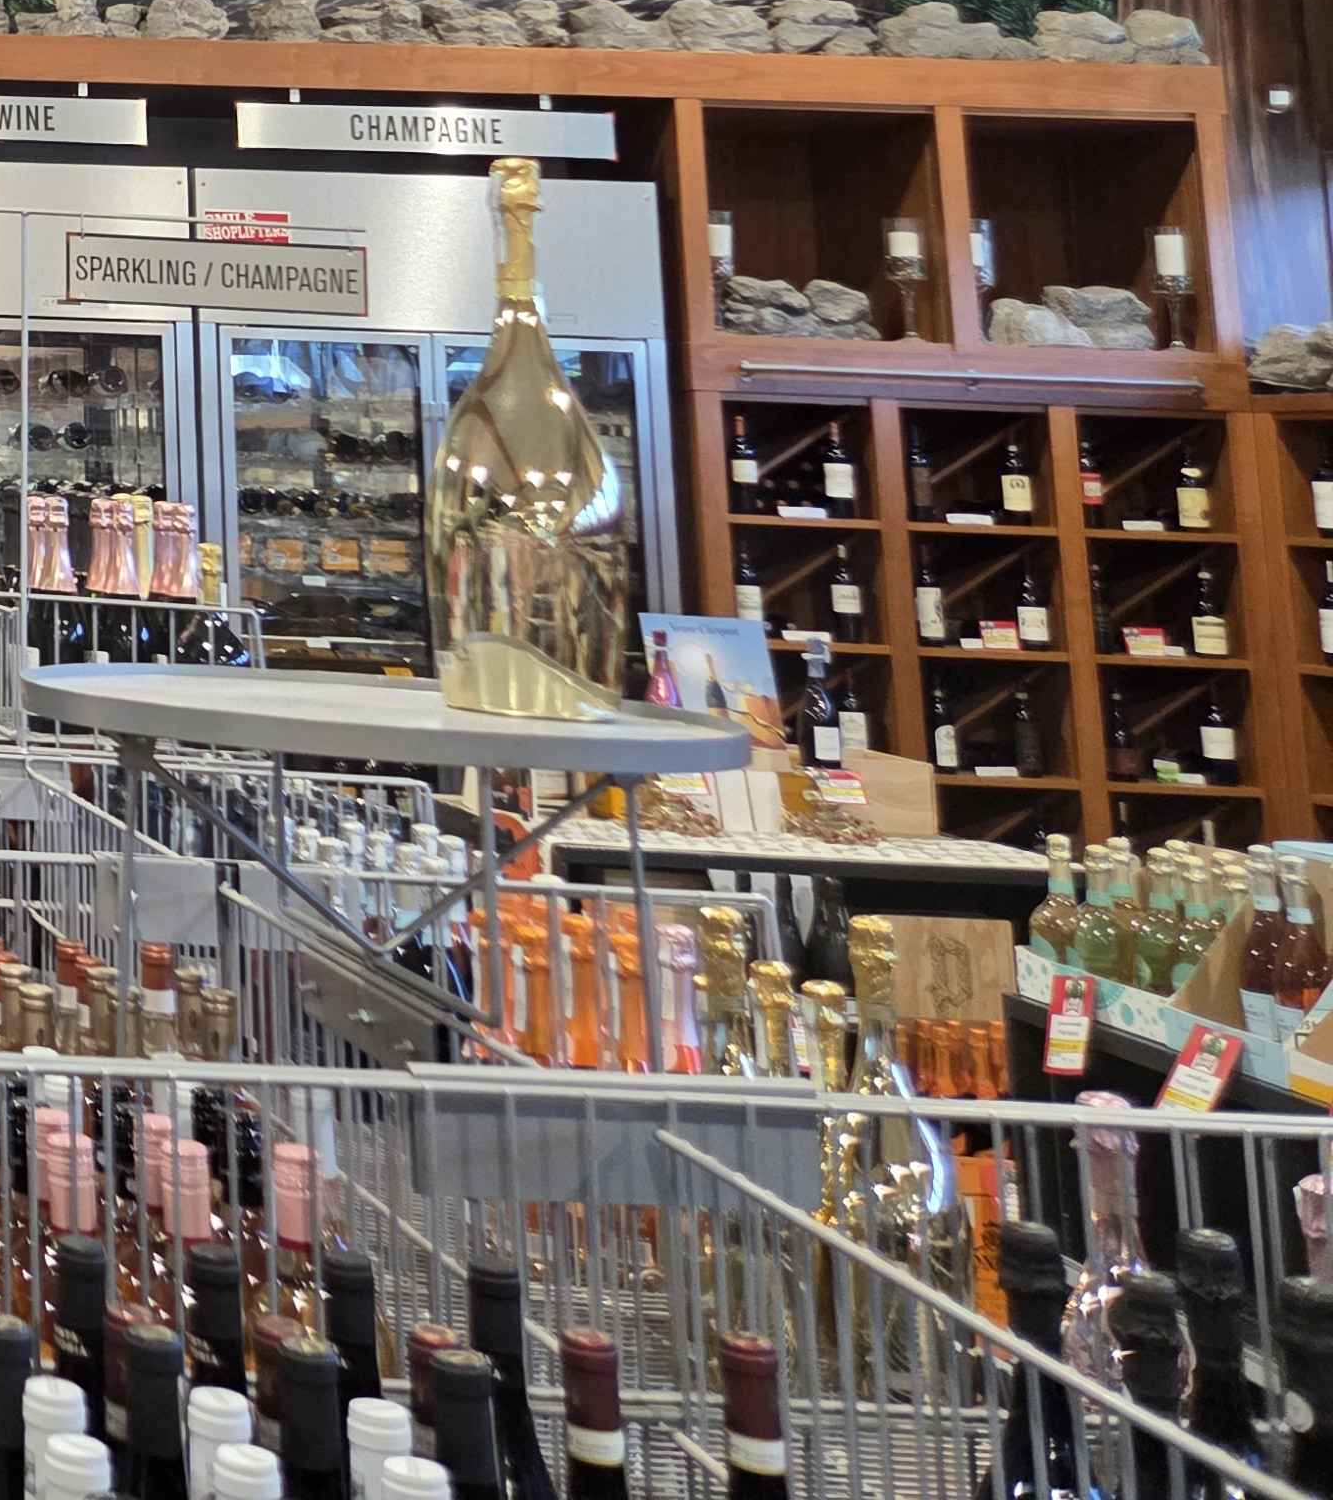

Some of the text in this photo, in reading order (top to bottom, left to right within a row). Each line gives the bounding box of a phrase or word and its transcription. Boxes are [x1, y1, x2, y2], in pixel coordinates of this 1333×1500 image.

[349, 113, 504, 145] CHAMPAGNE
[205, 224, 289, 240] SHOPLIFTERS
[75, 254, 197, 287] SPARKLING
[220, 261, 359, 295] CHAMPAGNE
